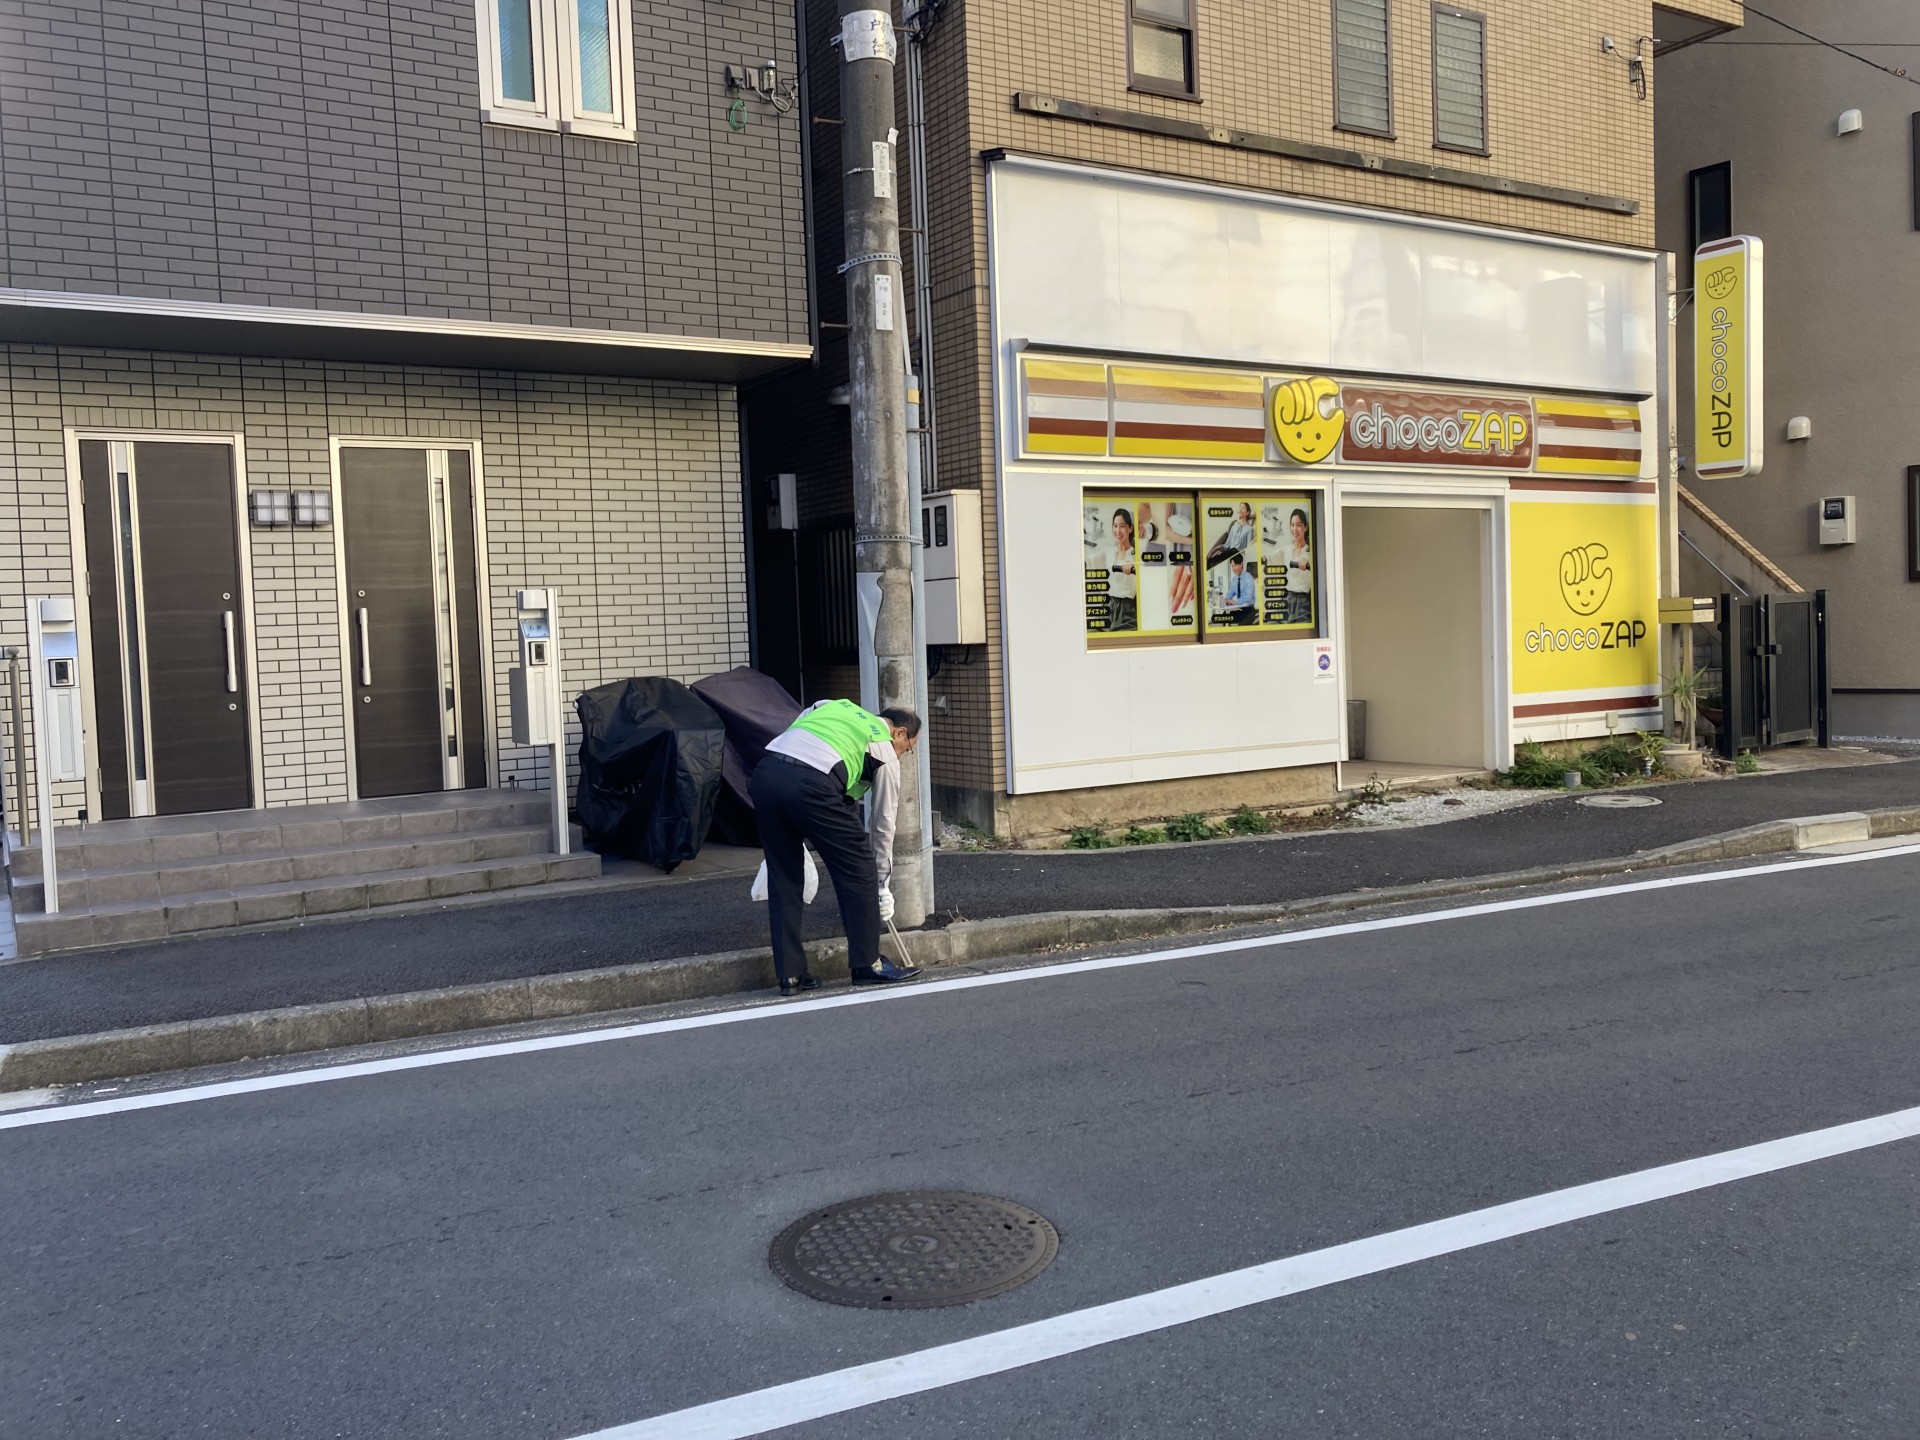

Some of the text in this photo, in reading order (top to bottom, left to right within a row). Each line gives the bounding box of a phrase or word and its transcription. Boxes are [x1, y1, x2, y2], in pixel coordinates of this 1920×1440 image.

[1711, 307, 1732, 448] chocoZAP
[1352, 403, 1528, 454] chocoZAP
[1525, 619, 1646, 653] chocoZAP
